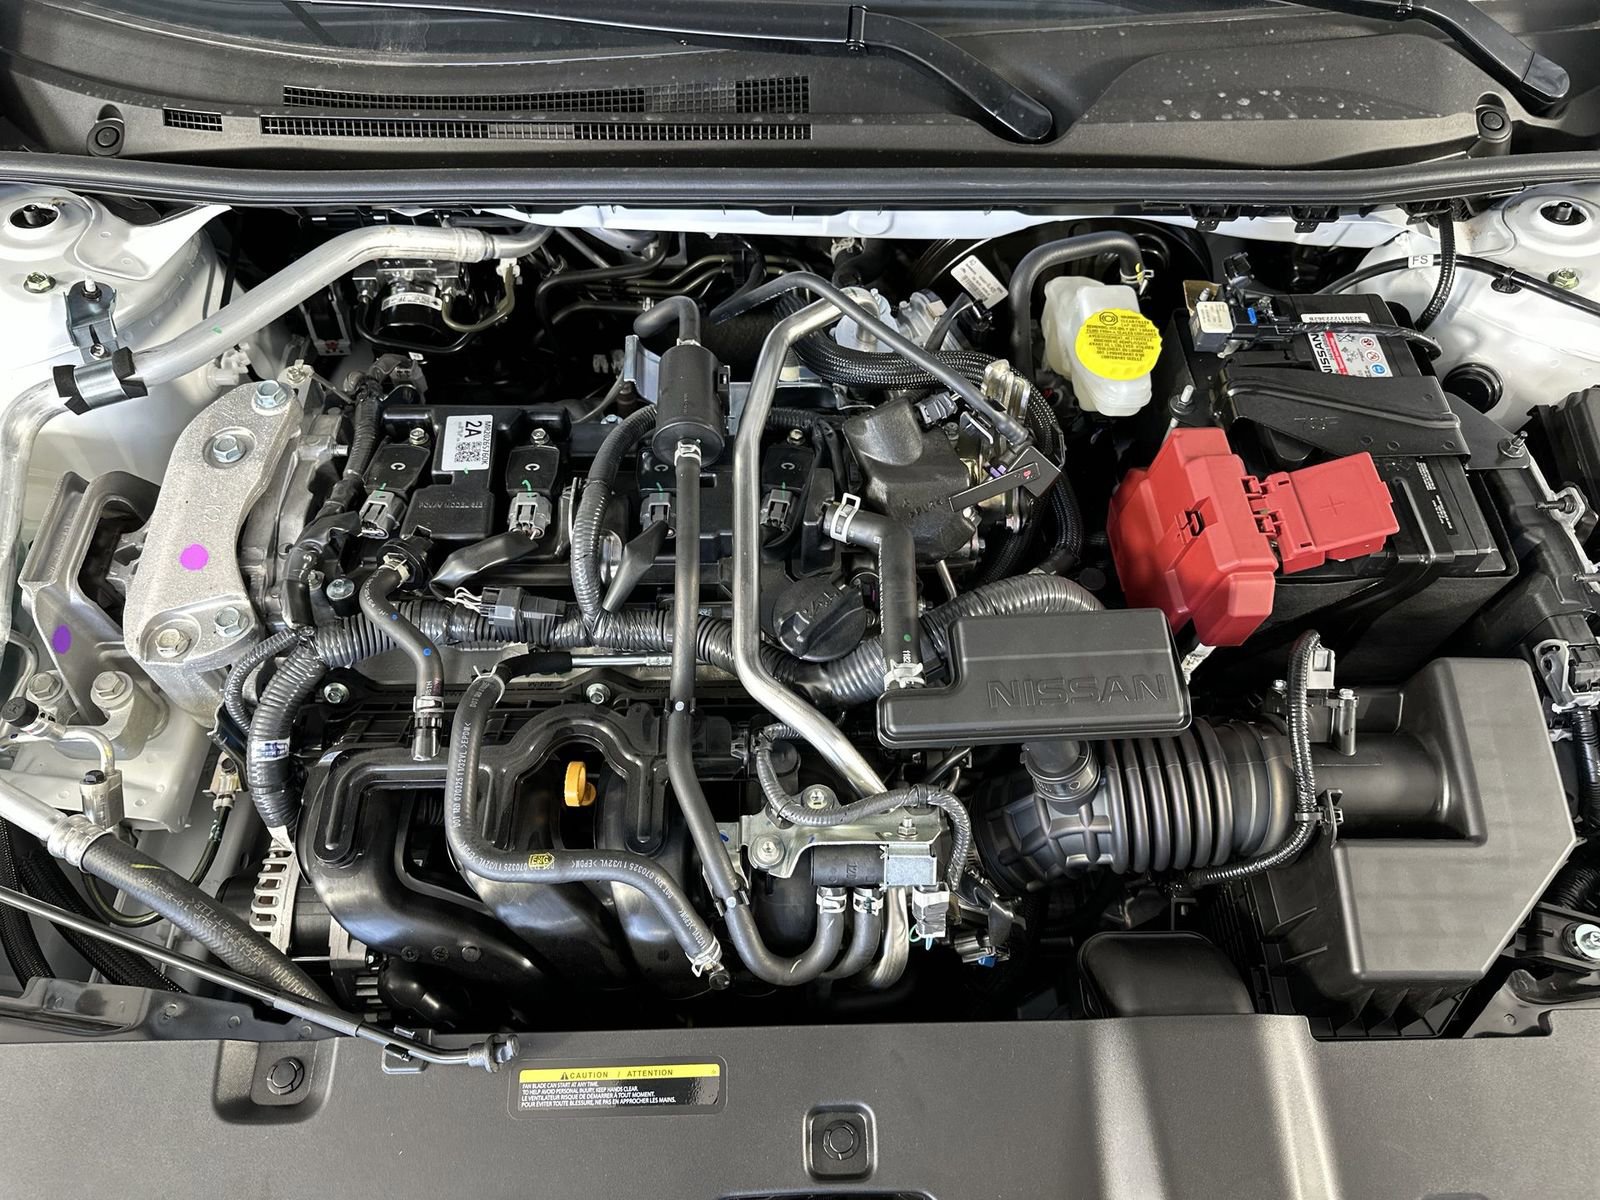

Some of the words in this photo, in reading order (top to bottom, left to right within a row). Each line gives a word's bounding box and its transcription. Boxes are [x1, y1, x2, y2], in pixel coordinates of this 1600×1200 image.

[1412, 255, 1428, 265] FS
[464, 420, 483, 438] 2A
[390, 462, 406, 471] C
[524, 463, 541, 471] C
[986, 674, 1170, 709] NISSAN
[570, 1071, 609, 1079] CAUTION
[627, 1069, 673, 1077] ATTENTION
